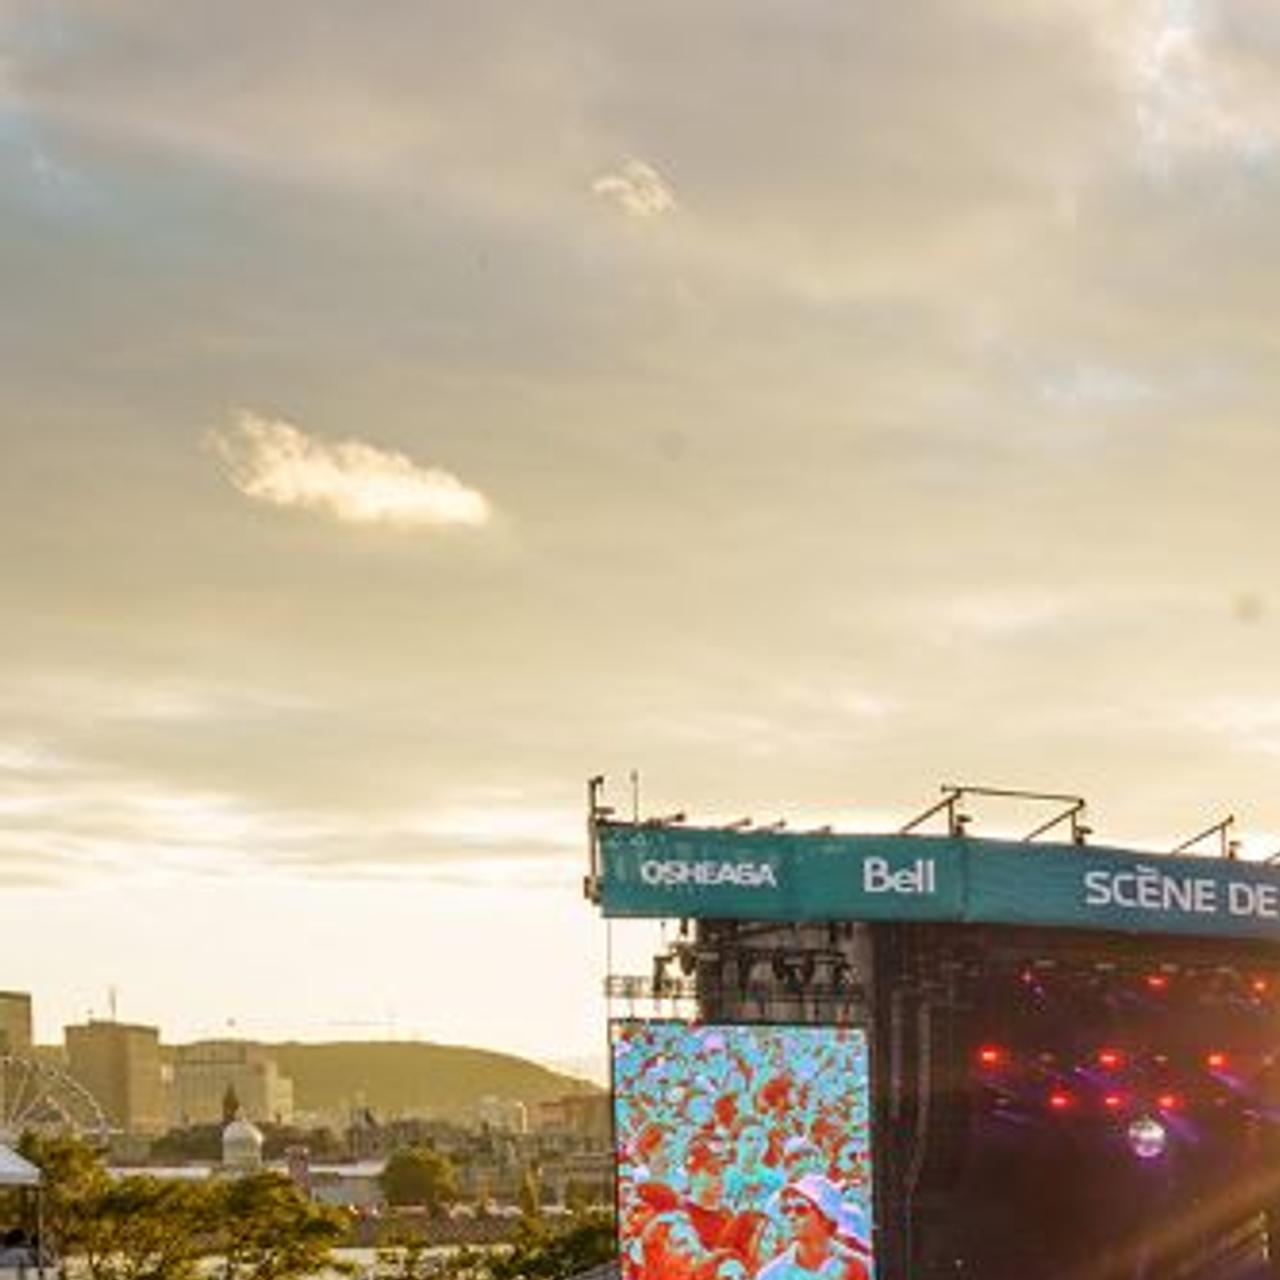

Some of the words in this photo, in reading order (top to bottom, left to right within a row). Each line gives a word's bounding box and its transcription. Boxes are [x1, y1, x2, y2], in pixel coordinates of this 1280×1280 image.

[862, 856, 936, 893] Bell
[1084, 864, 1217, 913] SCÈNE
[1228, 882, 1280, 917] DE
